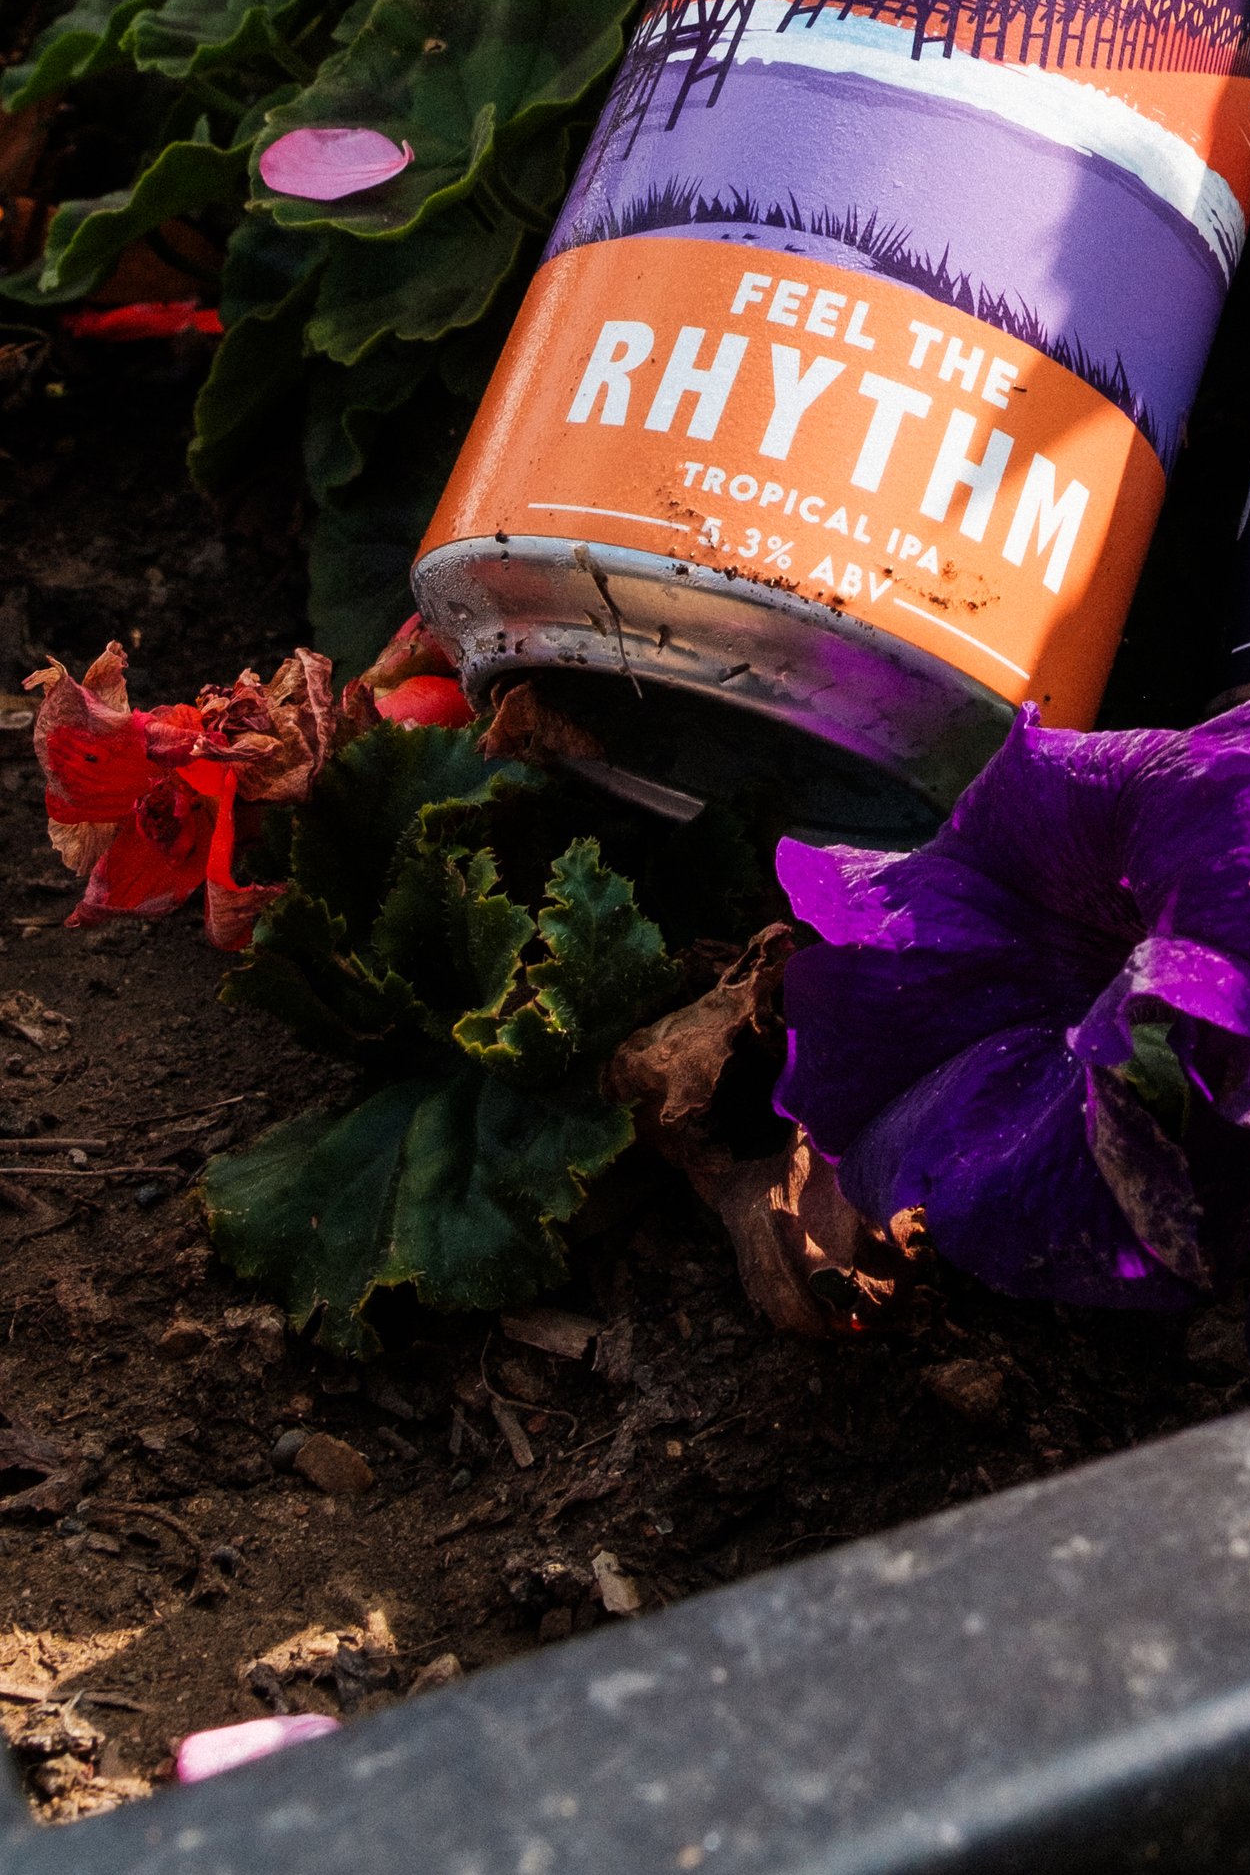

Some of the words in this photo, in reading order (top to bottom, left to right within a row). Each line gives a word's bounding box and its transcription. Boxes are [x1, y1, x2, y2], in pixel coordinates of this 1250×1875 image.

[730, 271, 876, 352] FEEL
[908, 320, 1019, 409] THE
[566, 320, 1091, 595] RHYTHM
[683, 460, 872, 544] TROPICAL
[885, 527, 939, 575] IPA
[697, 516, 795, 570] 5.3%
[808, 554, 893, 603] ABV
